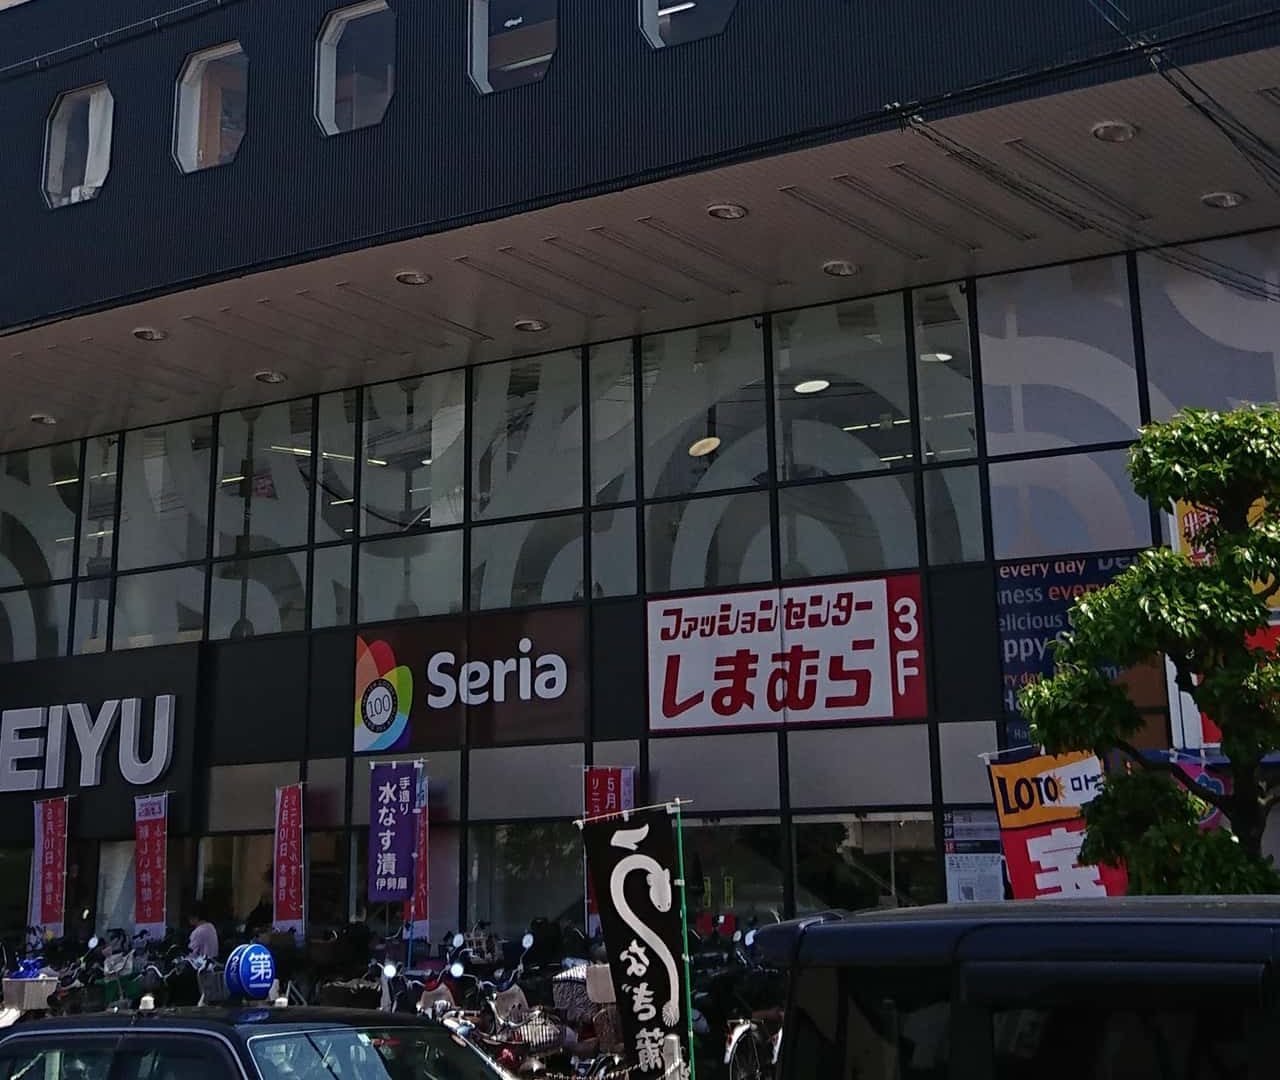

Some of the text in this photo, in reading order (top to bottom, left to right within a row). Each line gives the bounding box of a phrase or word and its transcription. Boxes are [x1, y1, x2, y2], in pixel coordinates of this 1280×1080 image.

[1000, 560, 1049, 579] every
[1054, 558, 1086, 576] day
[659, 591, 873, 642] ファッションセンター
[425, 638, 568, 710] Seria
[661, 637, 876, 718] しまむら
[368, 695, 390, 718] 100
[996, 775, 1059, 815] LOTO
[376, 781, 397, 875] 水なす漬
